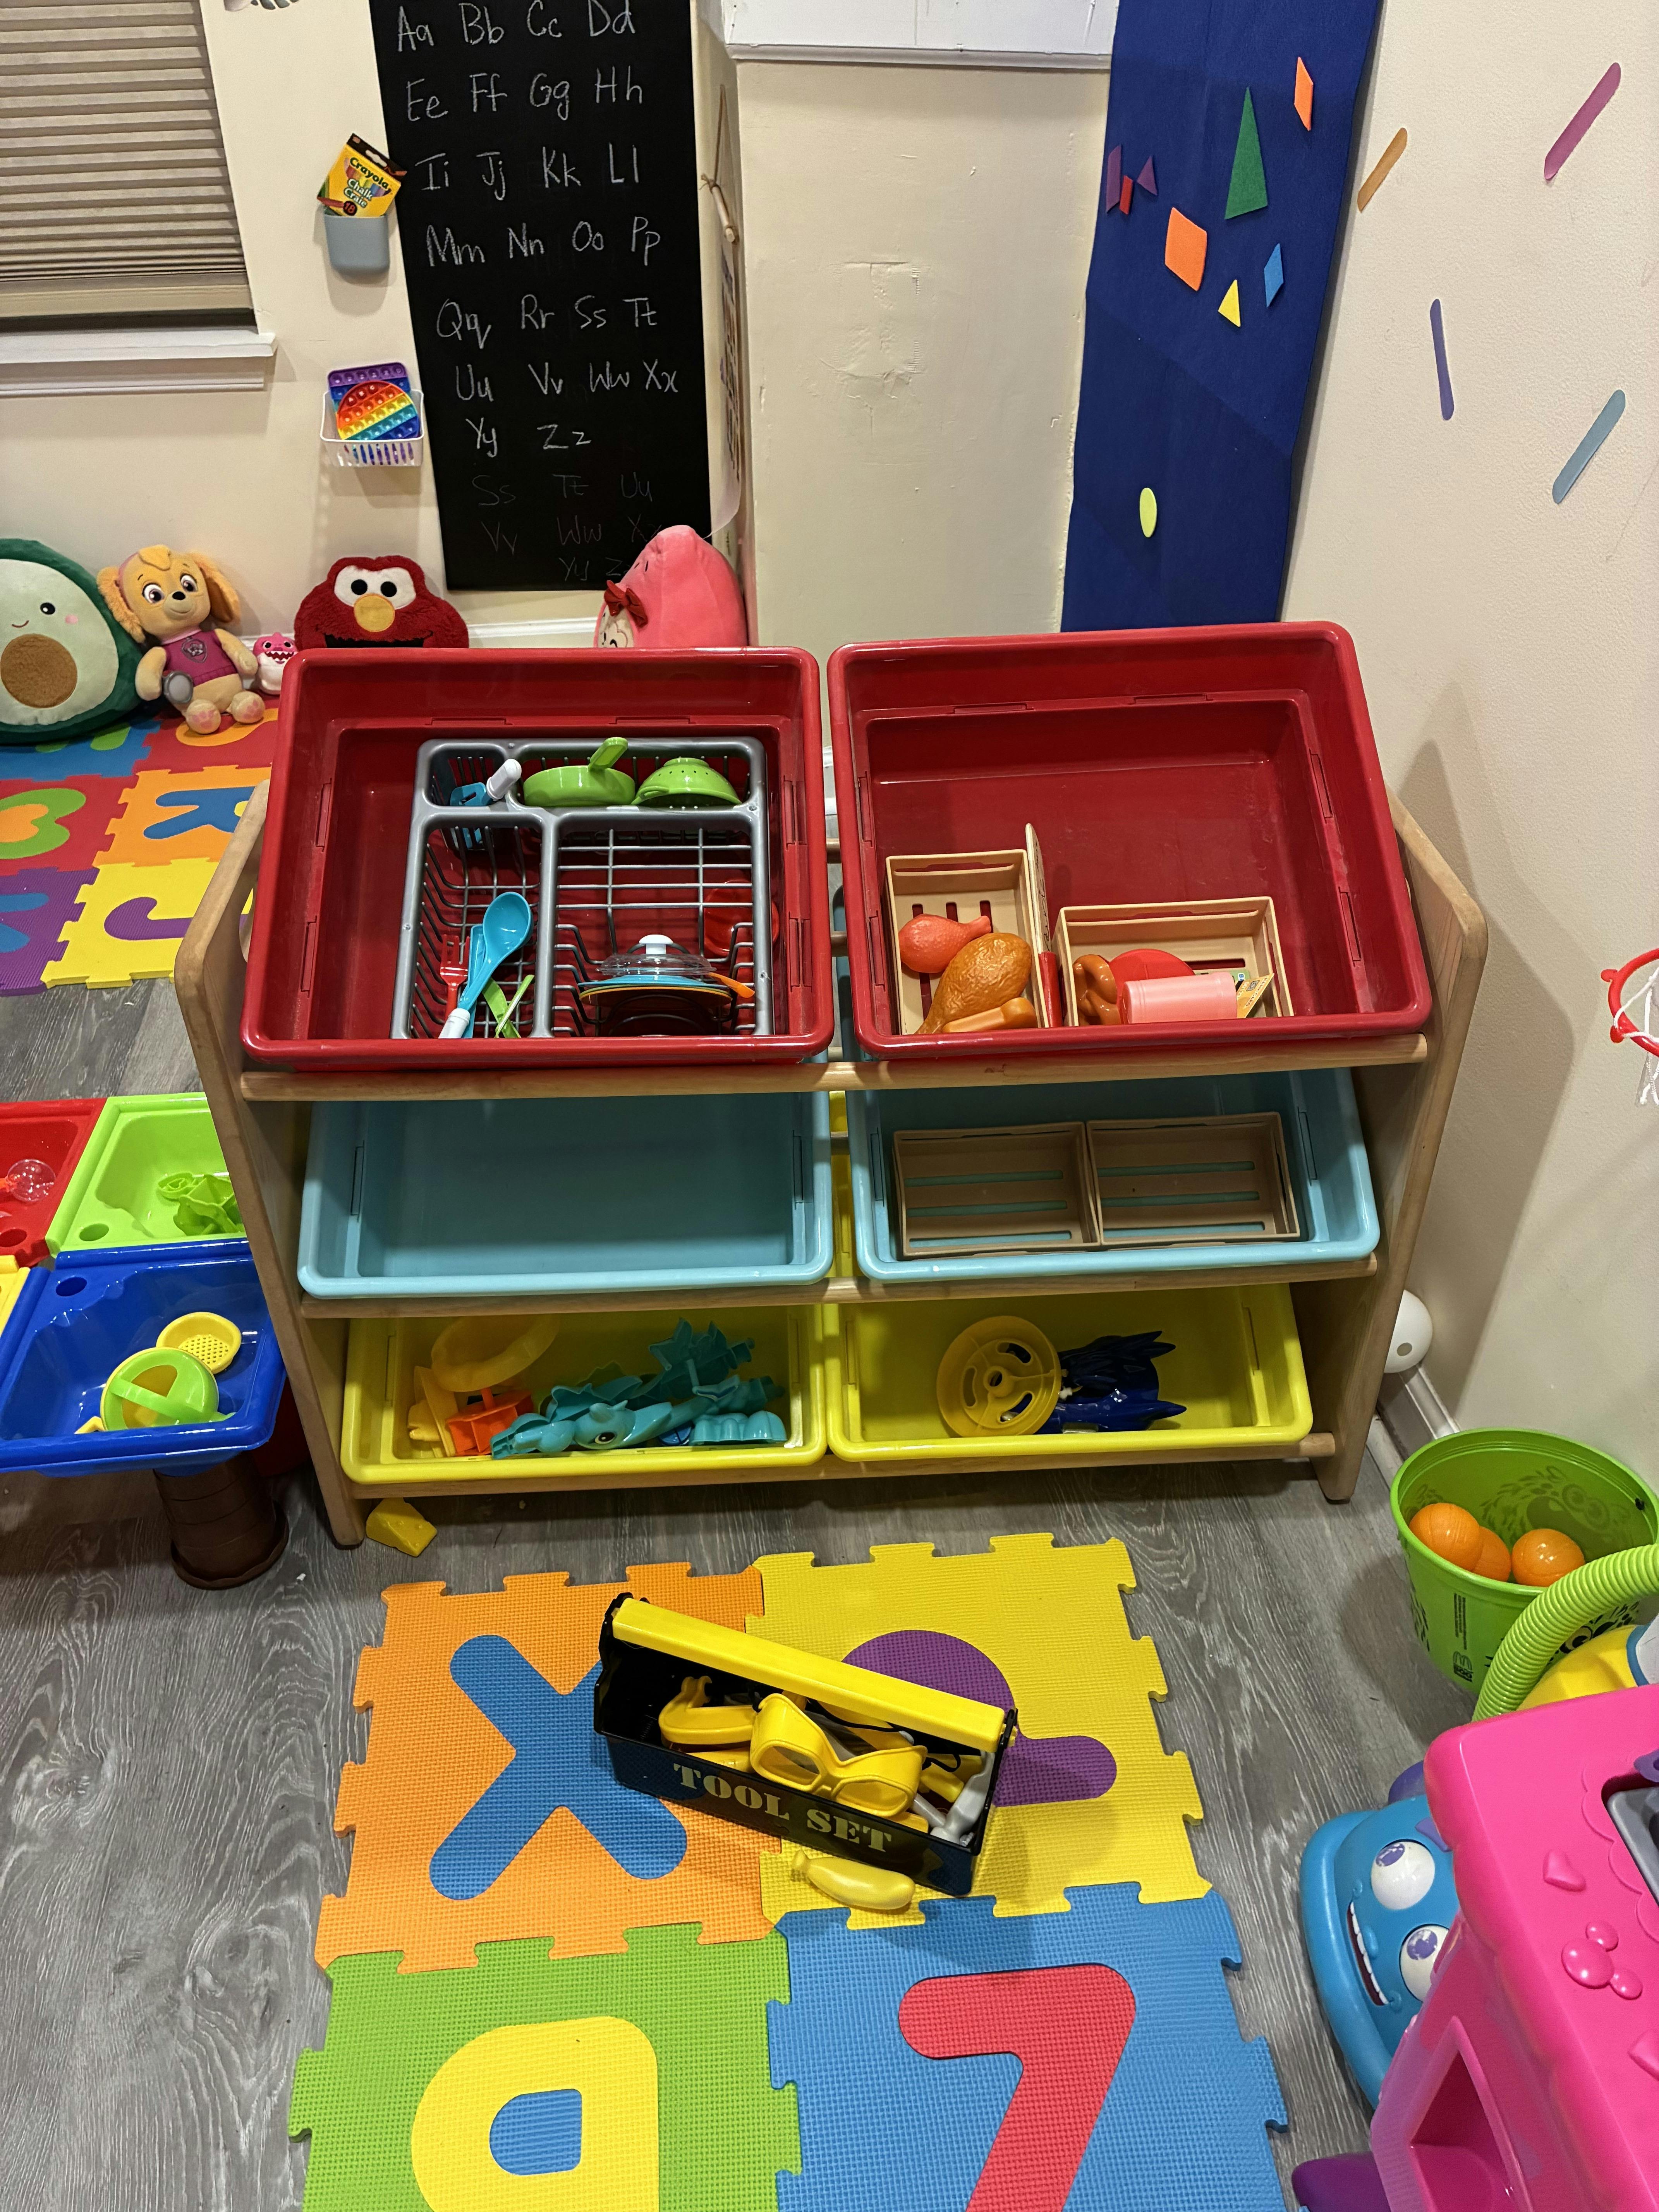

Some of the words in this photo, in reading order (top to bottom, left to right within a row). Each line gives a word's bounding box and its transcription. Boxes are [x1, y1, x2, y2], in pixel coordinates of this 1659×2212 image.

[398, 6, 434, 52] Aa
[459, 3, 504, 45] Bb
[527, 0, 562, 37] Cc
[588, 0, 635, 36] Dd
[407, 79, 448, 121] Ee
[470, 73, 507, 112] Ff
[530, 74, 569, 120] Gg
[595, 66, 642, 103] Hh
[348, 178, 373, 200] Chalk
[350, 157, 389, 189] Crayola
[415, 153, 448, 190] Ii
[477, 152, 505, 200] Jj
[543, 147, 580, 188] Kk
[609, 143, 638, 183] Ll
[344, 187, 368, 208] Craie
[345, 202, 355, 213] 18
[427, 225, 485, 266] Mm
[507, 223, 544, 258] Nn
[573, 221, 603, 251] Oo
[632, 217, 660, 265] Pp
[437, 299, 491, 349] Qq
[522, 295, 554, 329] Rr
[575, 295, 606, 328] Ss
[623, 298, 657, 327] Tt
[457, 364, 493, 401] Uu
[528, 362, 563, 394] Vv
[590, 362, 629, 392] Ww
[643, 359, 678, 392] Xx
[466, 418, 497, 457] Yy
[673, 1763, 790, 1821] TOOL
[807, 1809, 893, 1853] SET
